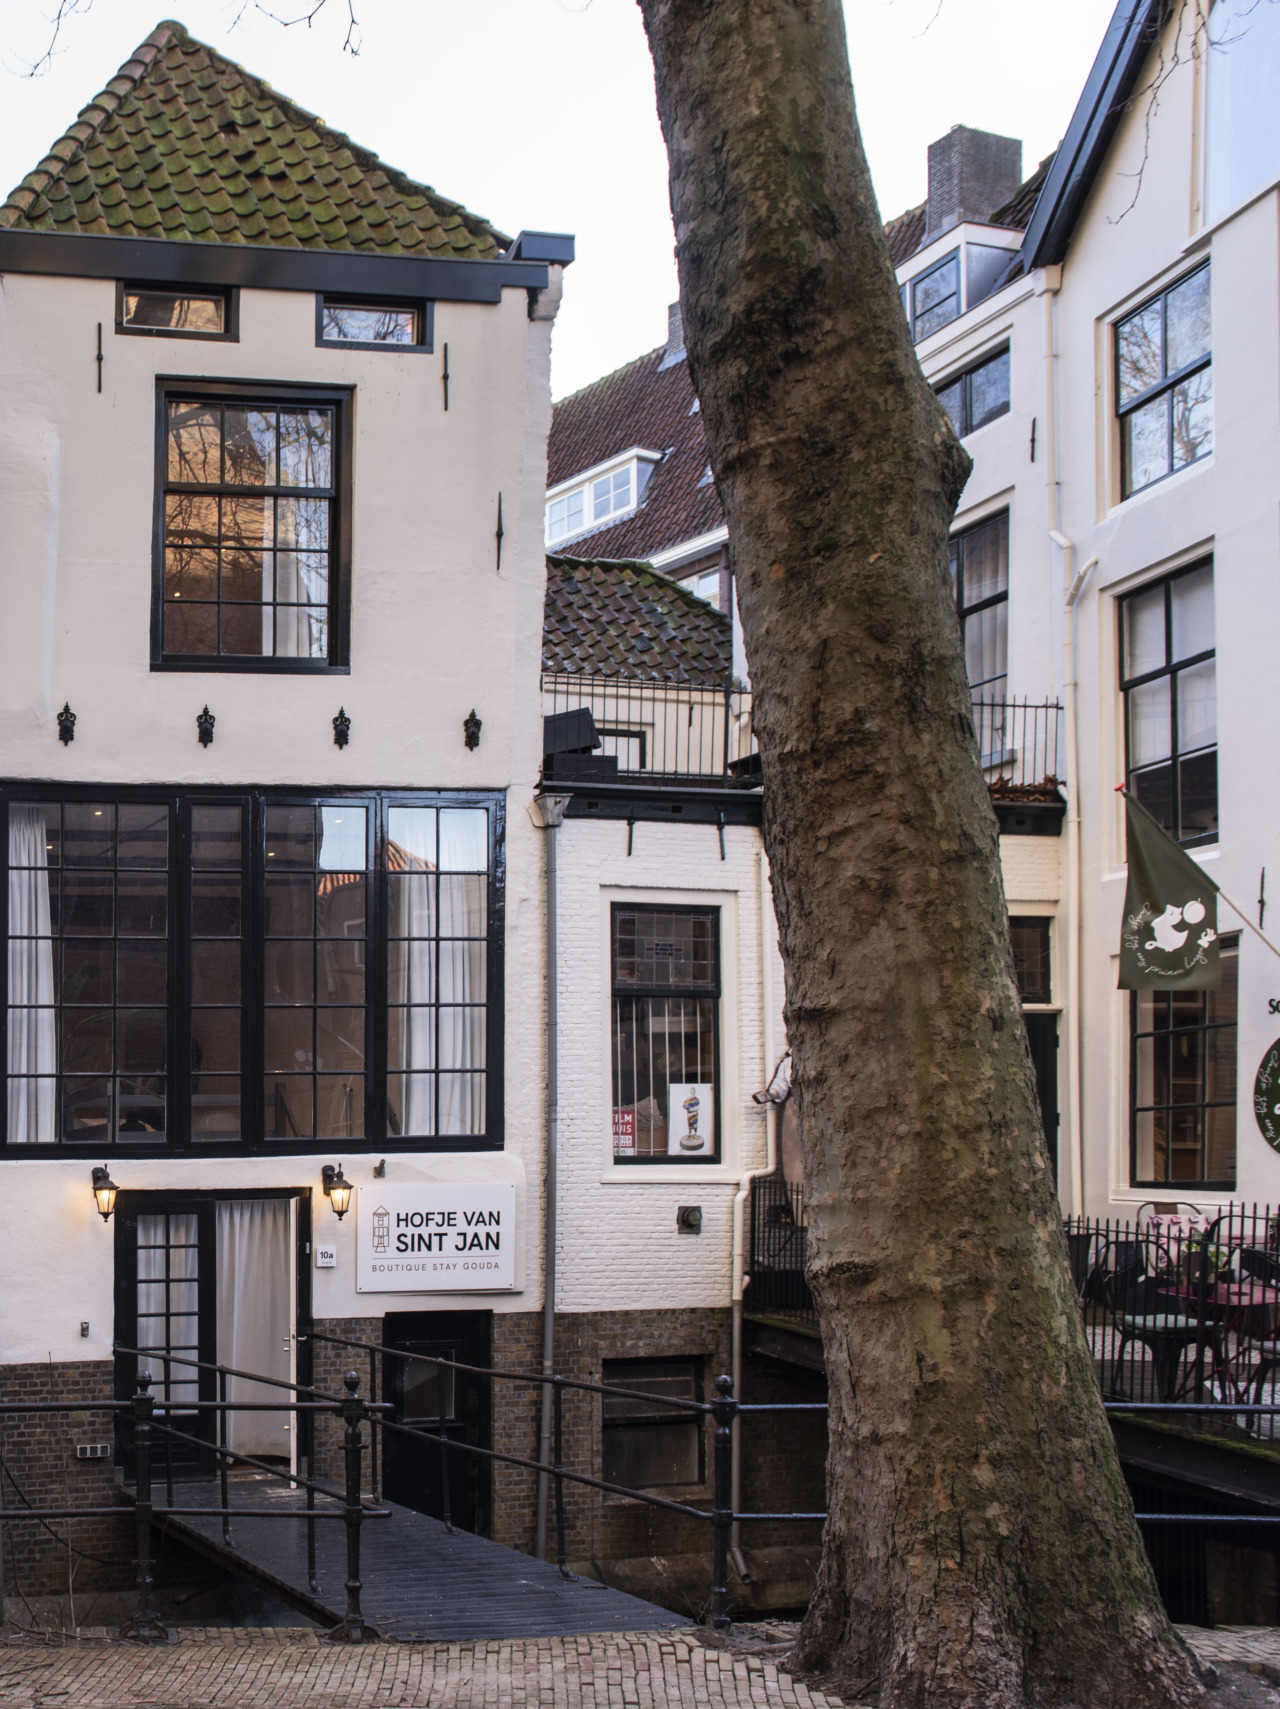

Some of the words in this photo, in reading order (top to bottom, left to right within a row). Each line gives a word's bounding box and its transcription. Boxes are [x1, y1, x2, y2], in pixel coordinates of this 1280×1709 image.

[396, 1212, 458, 1228] HOFJE
[463, 1211, 500, 1226] VAN
[395, 1232, 448, 1253] SINT
[454, 1231, 500, 1252] JAN
[319, 1251, 334, 1260] 10a
[372, 1263, 427, 1273] BOUTIQUE
[432, 1262, 458, 1272] STAY
[463, 1261, 500, 1271] GOUDA
